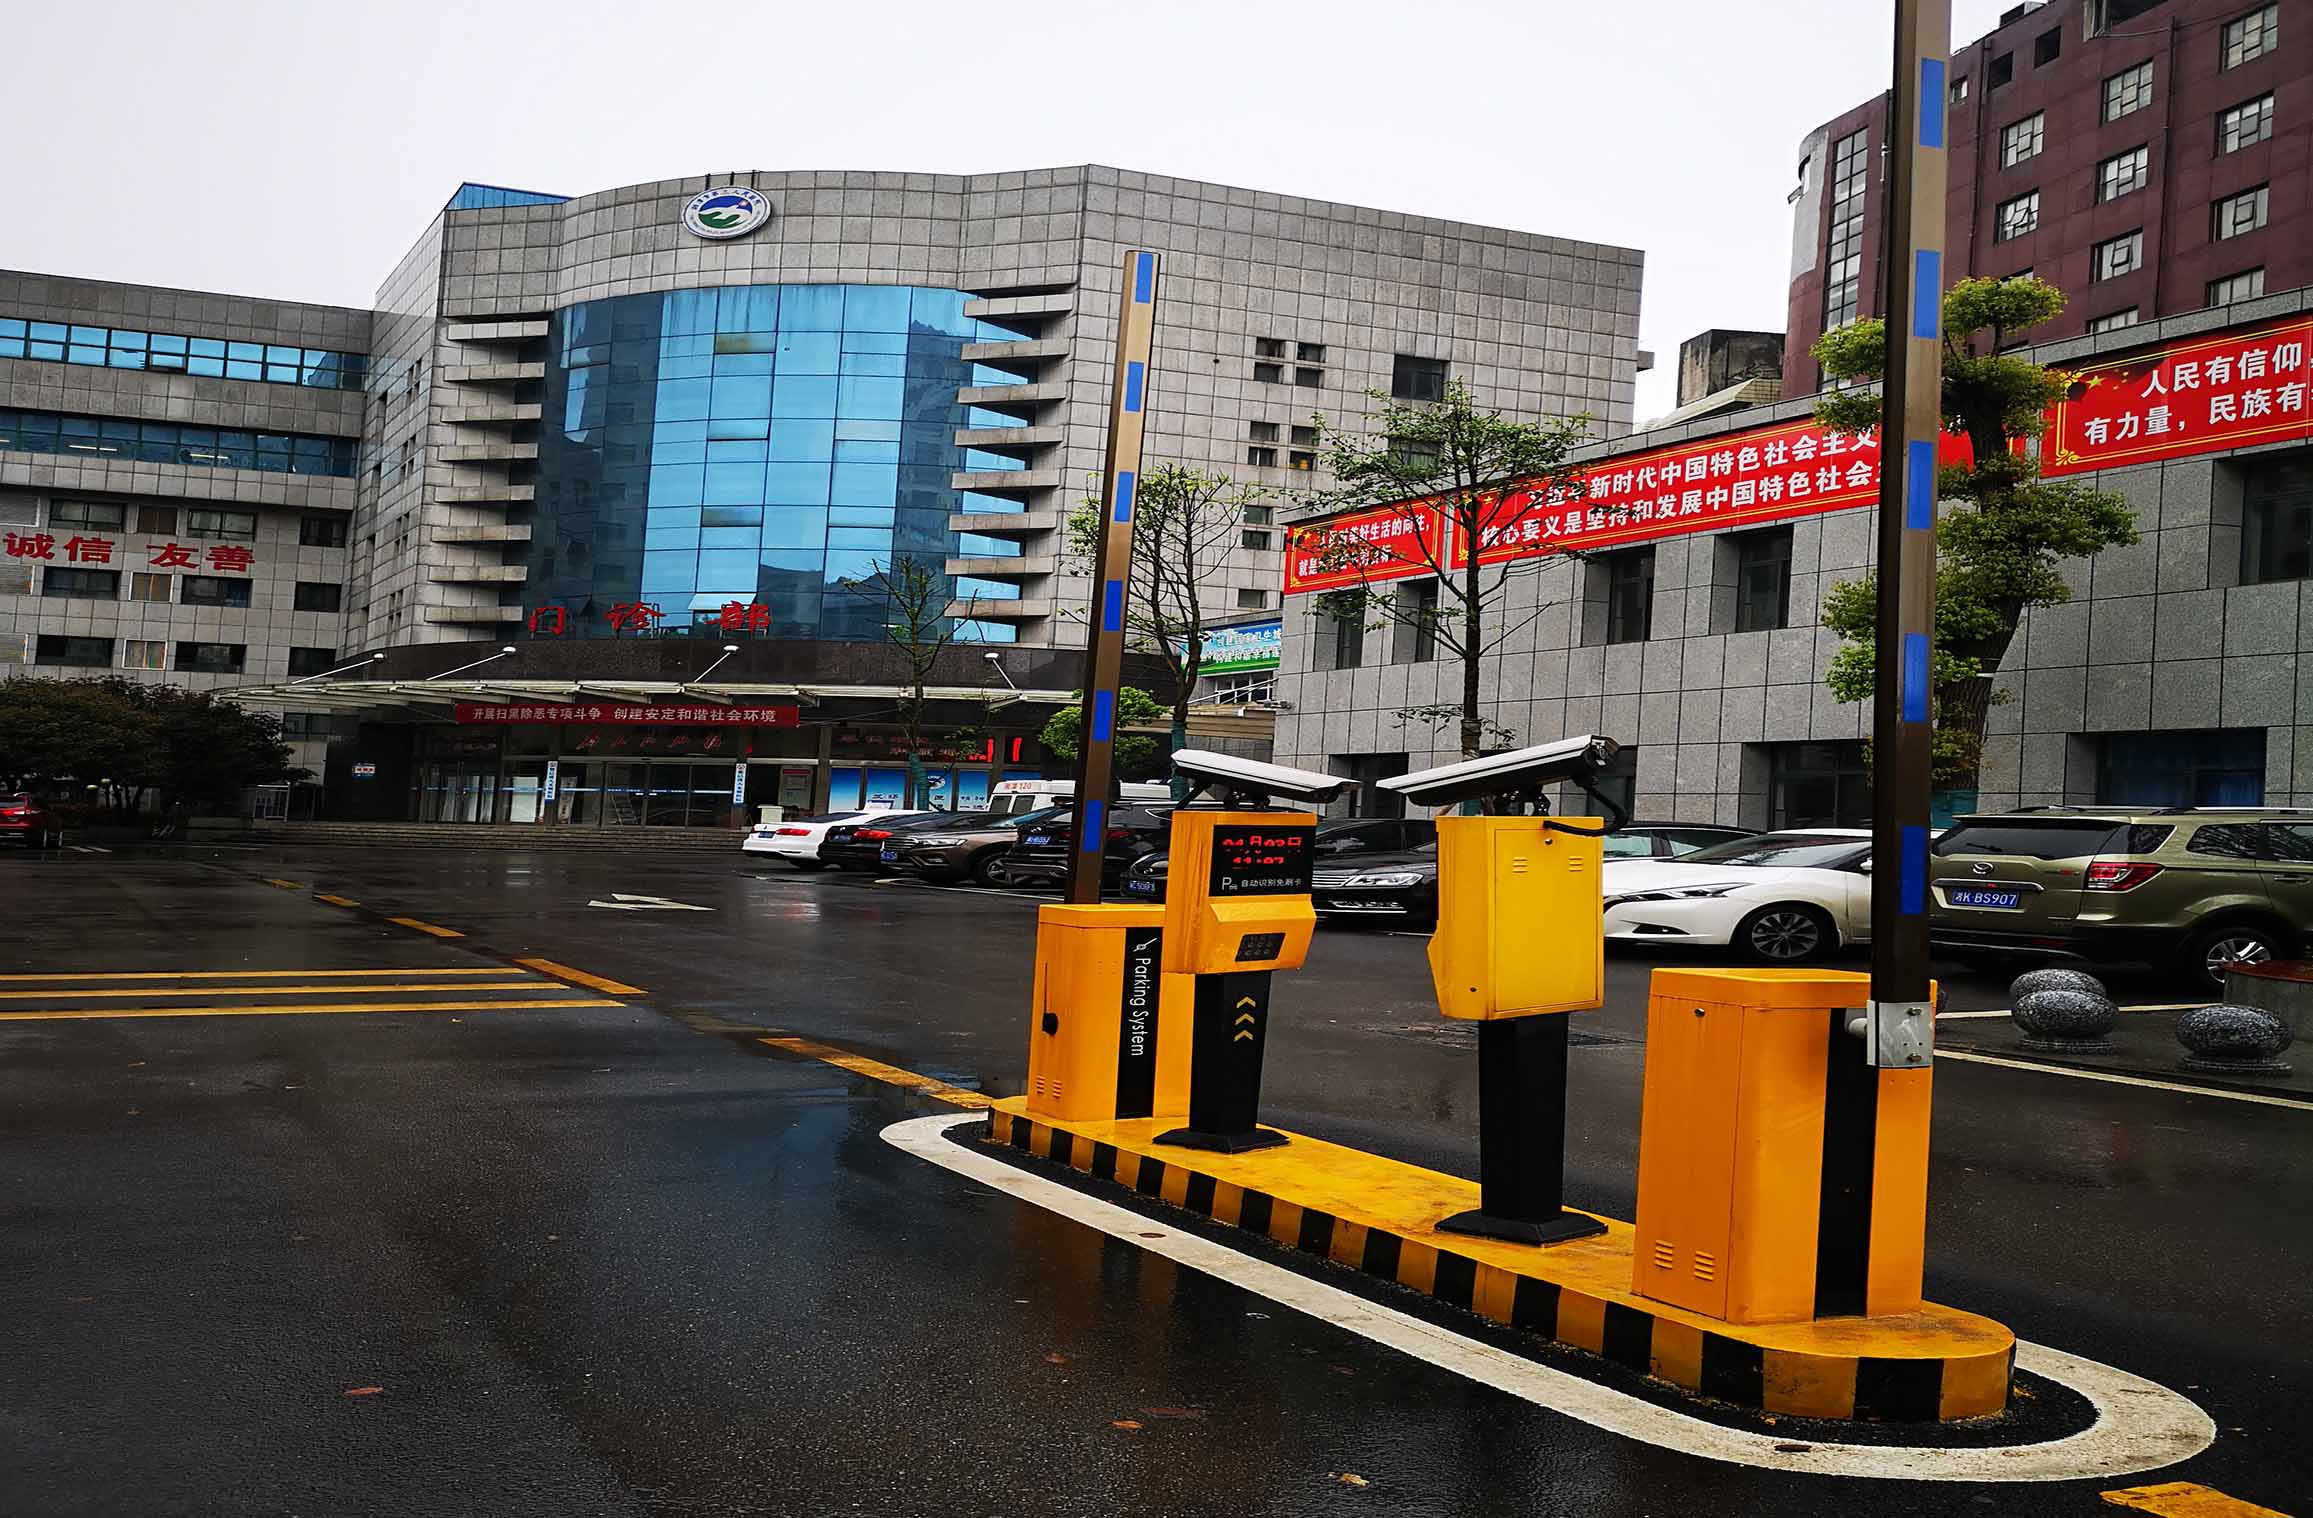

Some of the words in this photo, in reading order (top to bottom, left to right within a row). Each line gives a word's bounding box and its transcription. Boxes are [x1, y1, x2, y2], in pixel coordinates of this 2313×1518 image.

[2084, 382, 2313, 445] 有力量，民族有
[1481, 460, 1880, 546] 核心要义是坚持和发展中国特色社会
[3, 532, 115, 563] 诚信
[146, 542, 256, 573] 友善
[528, 600, 771, 635] 门诊部
[473, 707, 602, 721] 开展扫黑除恶专项斗争
[614, 707, 776, 723] 创建安定和谐社会环境
[1130, 958, 1151, 1006] Parking
[1129, 1010, 1149, 1056] System
